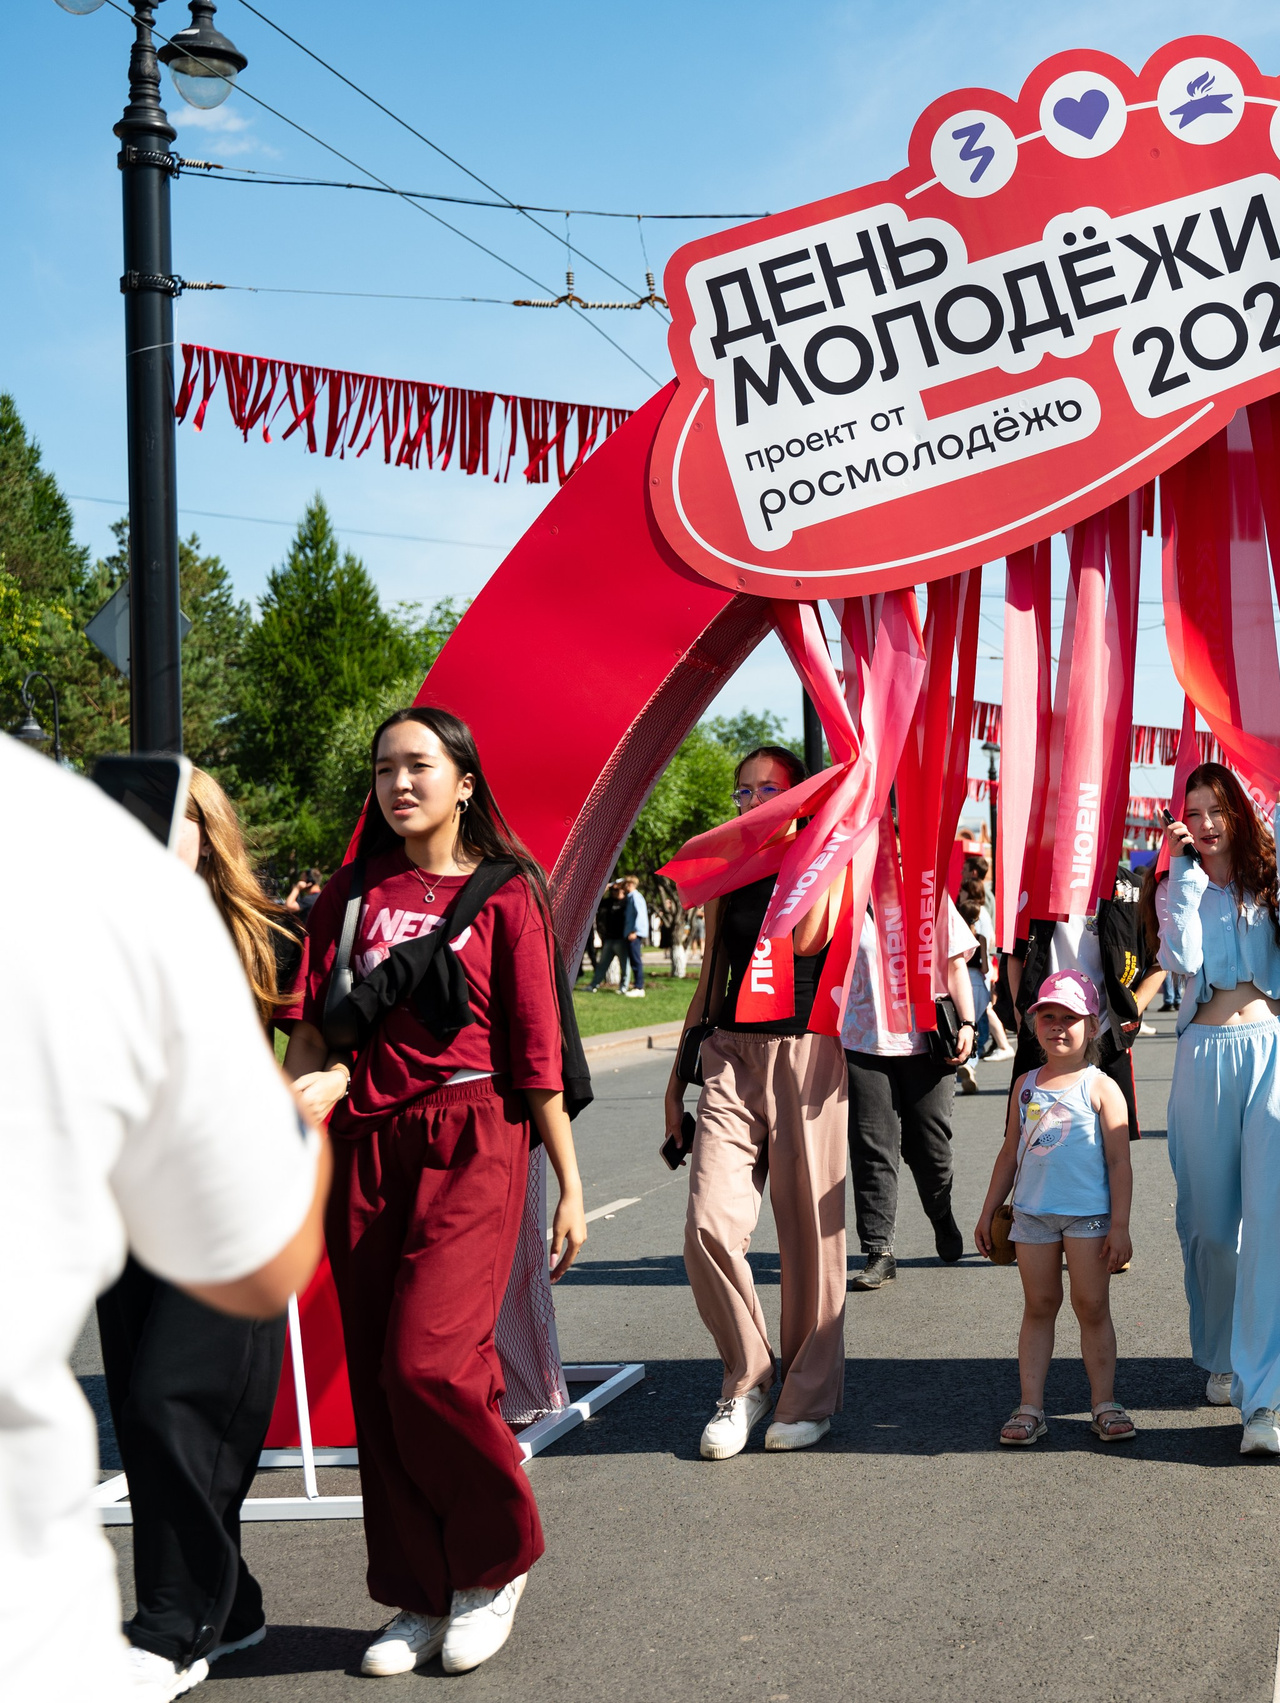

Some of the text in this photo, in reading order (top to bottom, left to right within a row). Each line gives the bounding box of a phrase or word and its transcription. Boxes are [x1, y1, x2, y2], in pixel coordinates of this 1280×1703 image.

[705, 222, 948, 360] ДЕНЬ
[745, 406, 905, 472] проект от
[759, 399, 1082, 531] росмолодёжь
